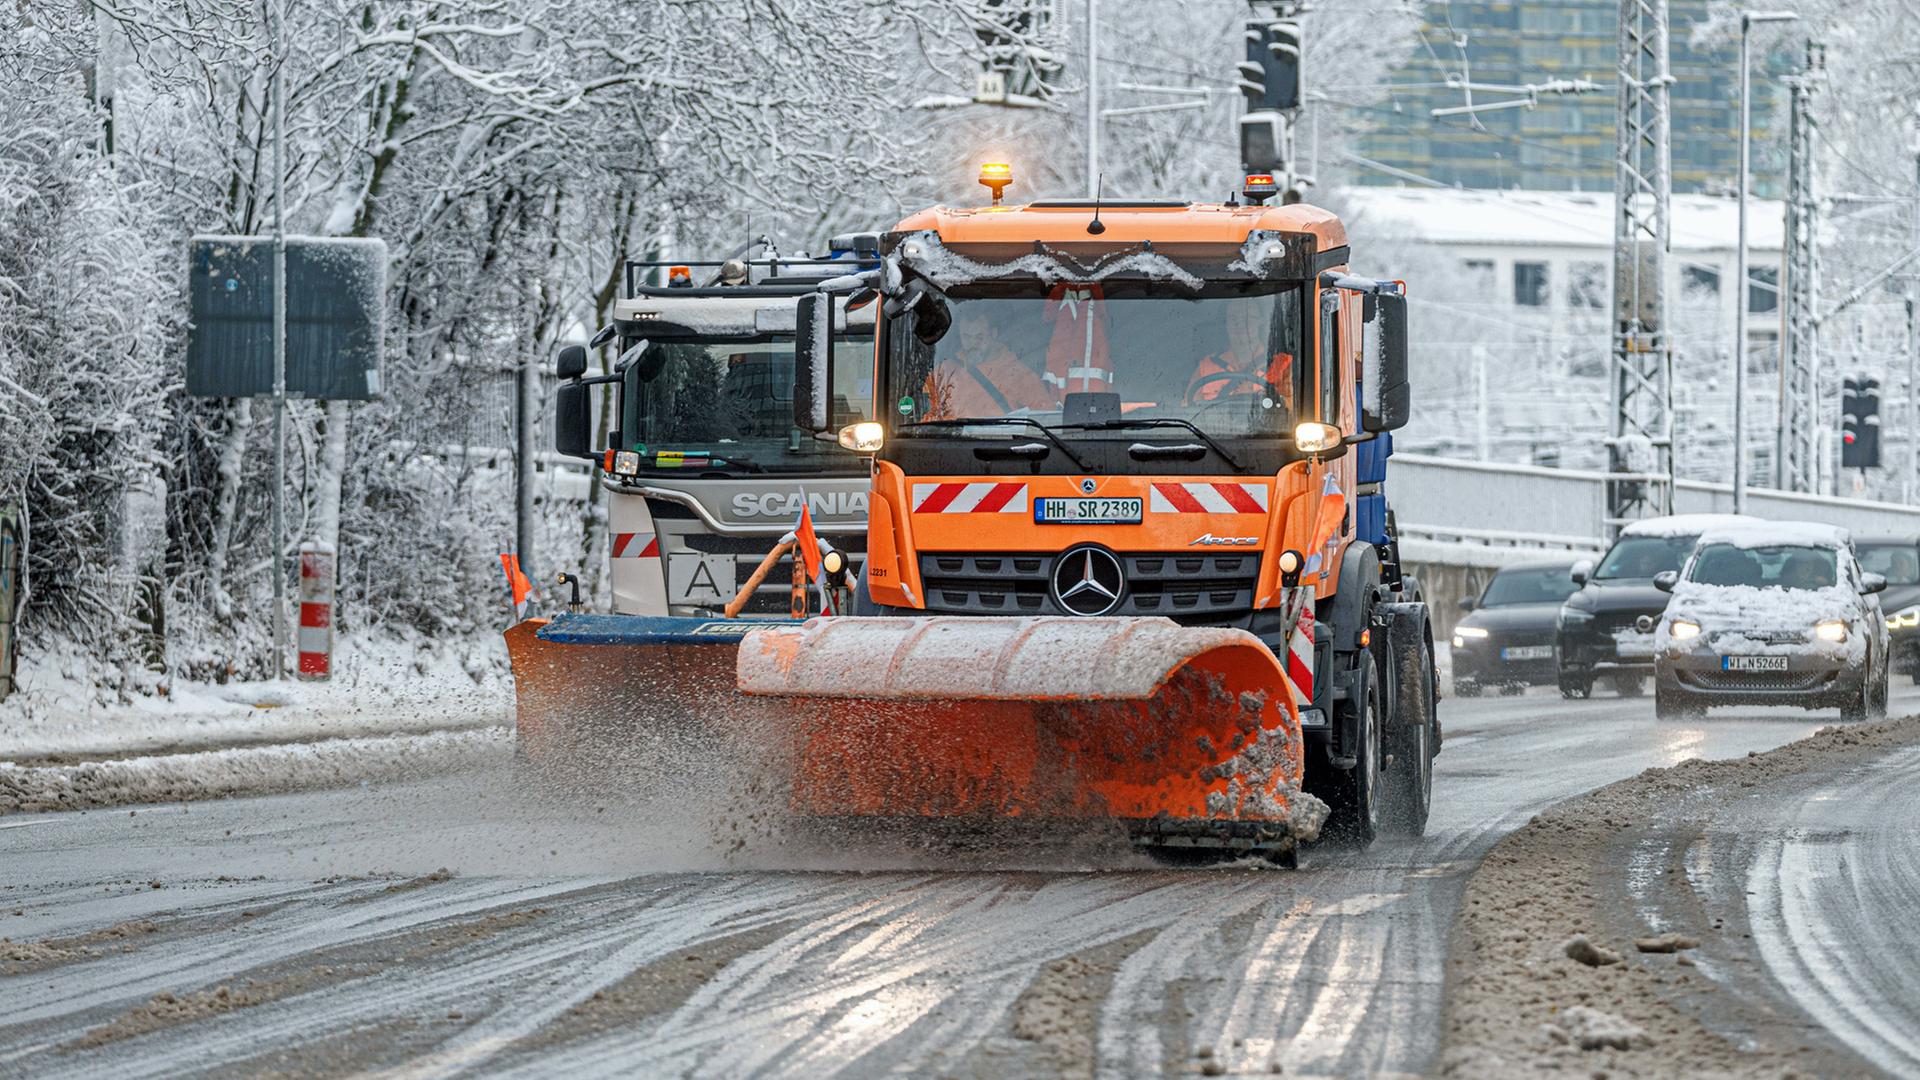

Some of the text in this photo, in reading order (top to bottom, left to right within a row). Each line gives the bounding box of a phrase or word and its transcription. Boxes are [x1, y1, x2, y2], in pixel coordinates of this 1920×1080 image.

[732, 492, 869, 516] SCANIA
[1046, 501, 1066, 518] HH
[1078, 501, 1098, 518] SR
[1101, 501, 1140, 518] 2389
[684, 560, 721, 597] A
[1729, 658, 1786, 669] WI N 5266E
